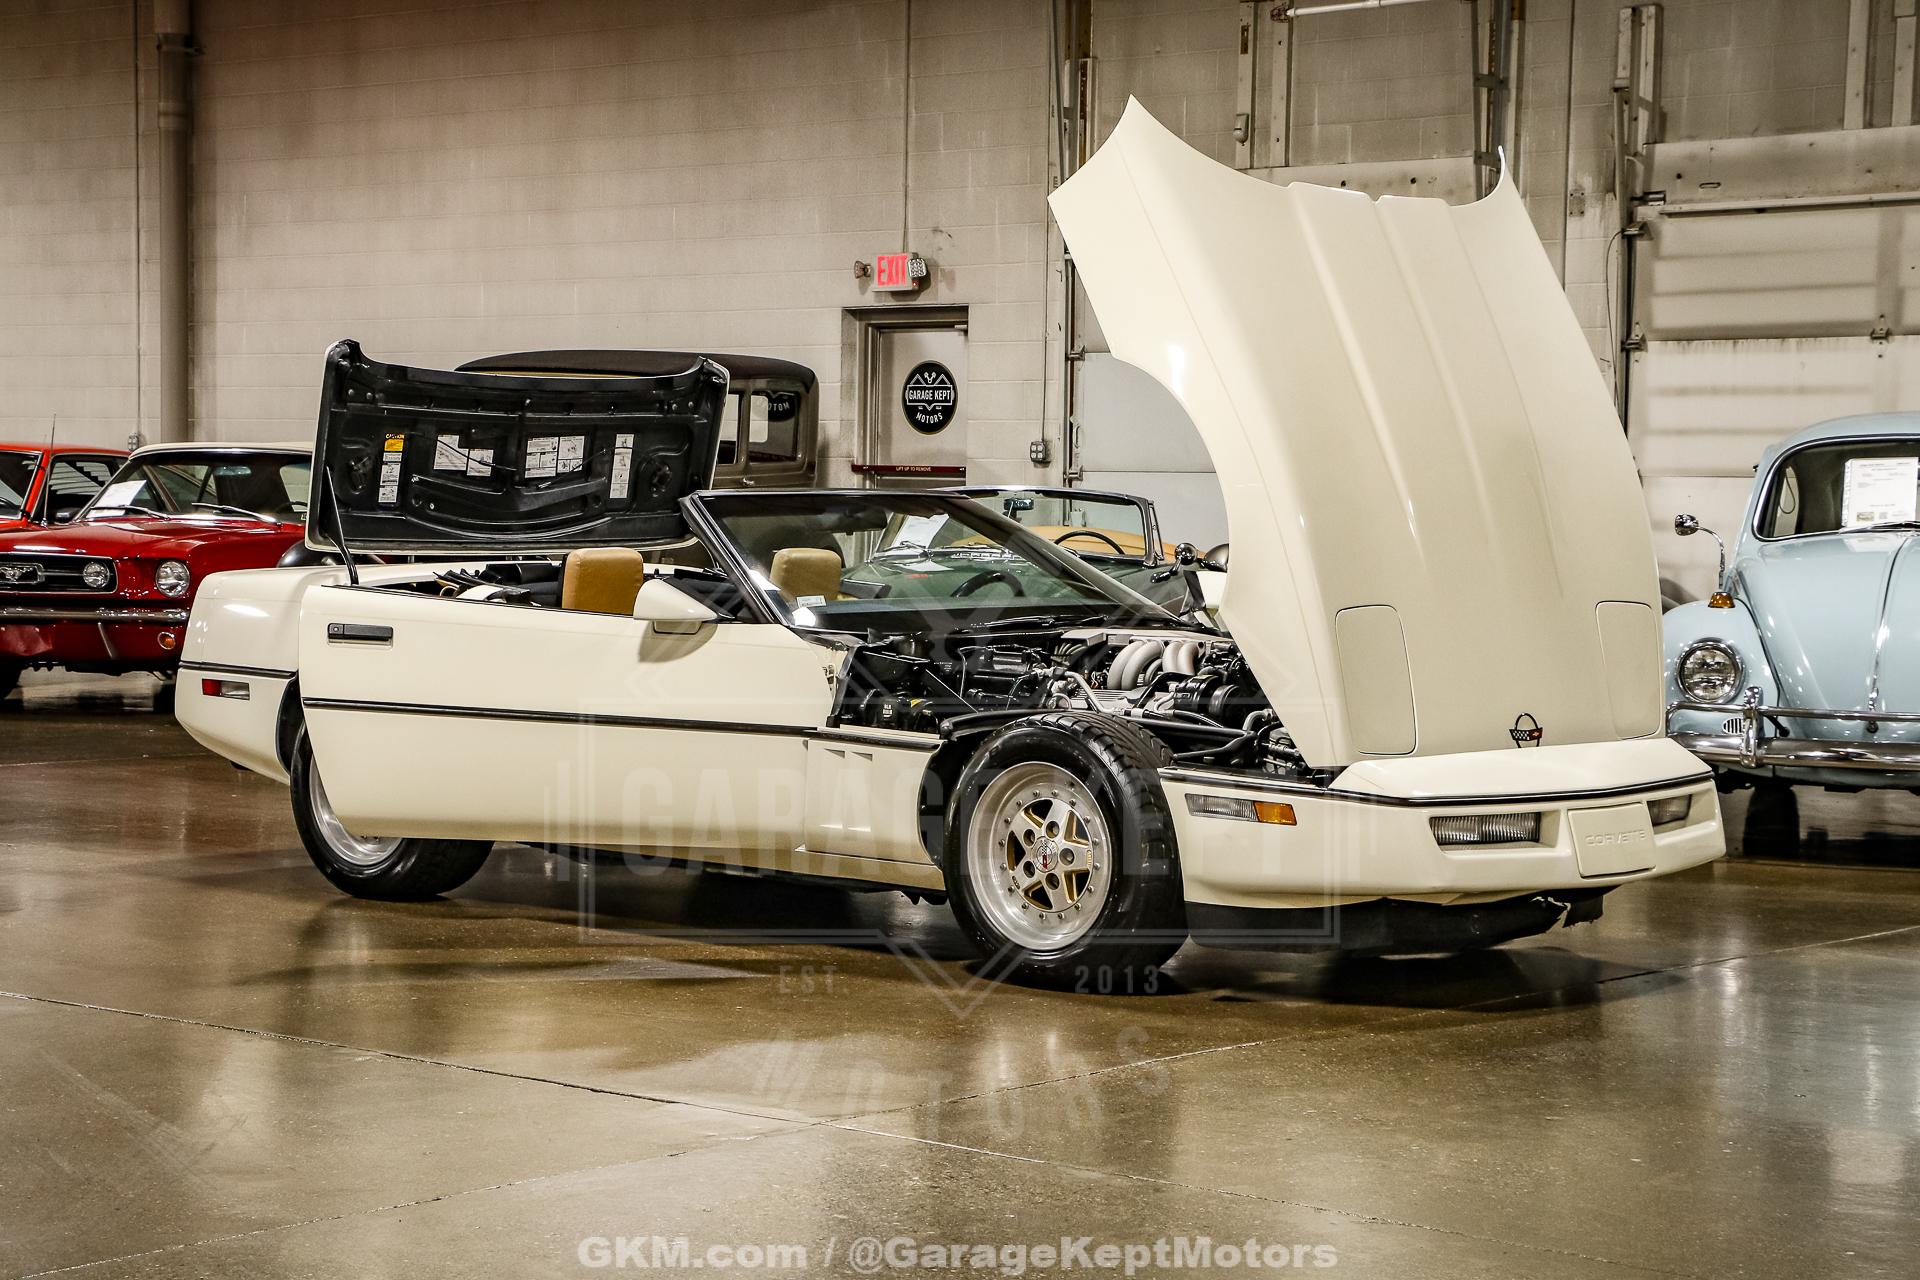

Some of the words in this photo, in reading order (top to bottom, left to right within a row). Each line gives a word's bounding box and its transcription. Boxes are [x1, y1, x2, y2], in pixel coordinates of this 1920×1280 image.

[877, 255, 907, 287] EXIT
[909, 390, 933, 400] GARAGE
[934, 390, 950, 400] KEPT
[916, 412, 943, 424] MOTORS
[1584, 829, 1648, 847] CORVETTE
